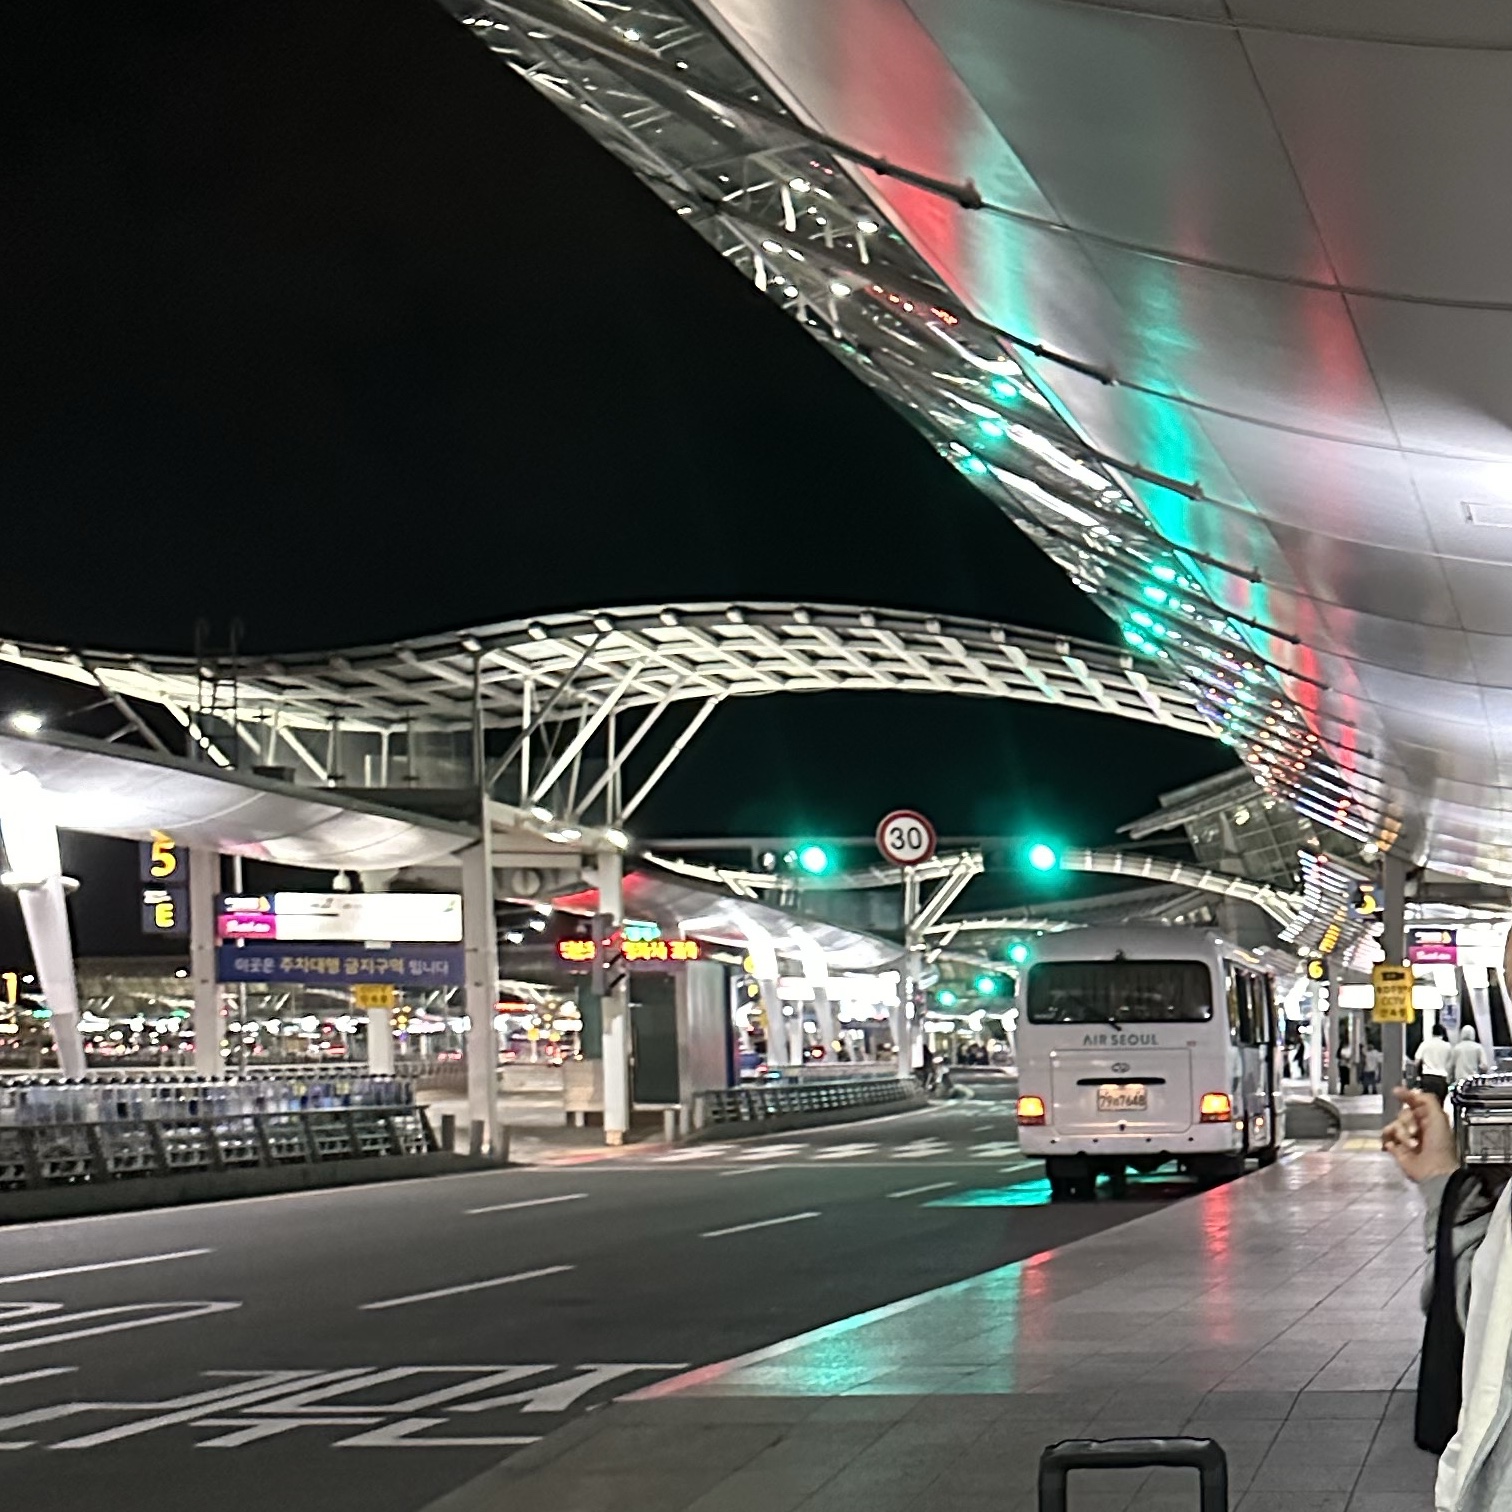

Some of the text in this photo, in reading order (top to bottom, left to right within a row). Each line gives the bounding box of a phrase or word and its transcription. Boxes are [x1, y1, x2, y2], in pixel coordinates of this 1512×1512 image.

[889, 827, 923, 850] 30
[150, 840, 177, 877] 5
[155, 902, 175, 928] E
[234, 956, 449, 975] 이곳은 주차대행 금지구역 입니다
[1308, 960, 1324, 979] 6
[1083, 1034, 1159, 1046] AIR SEOUL
